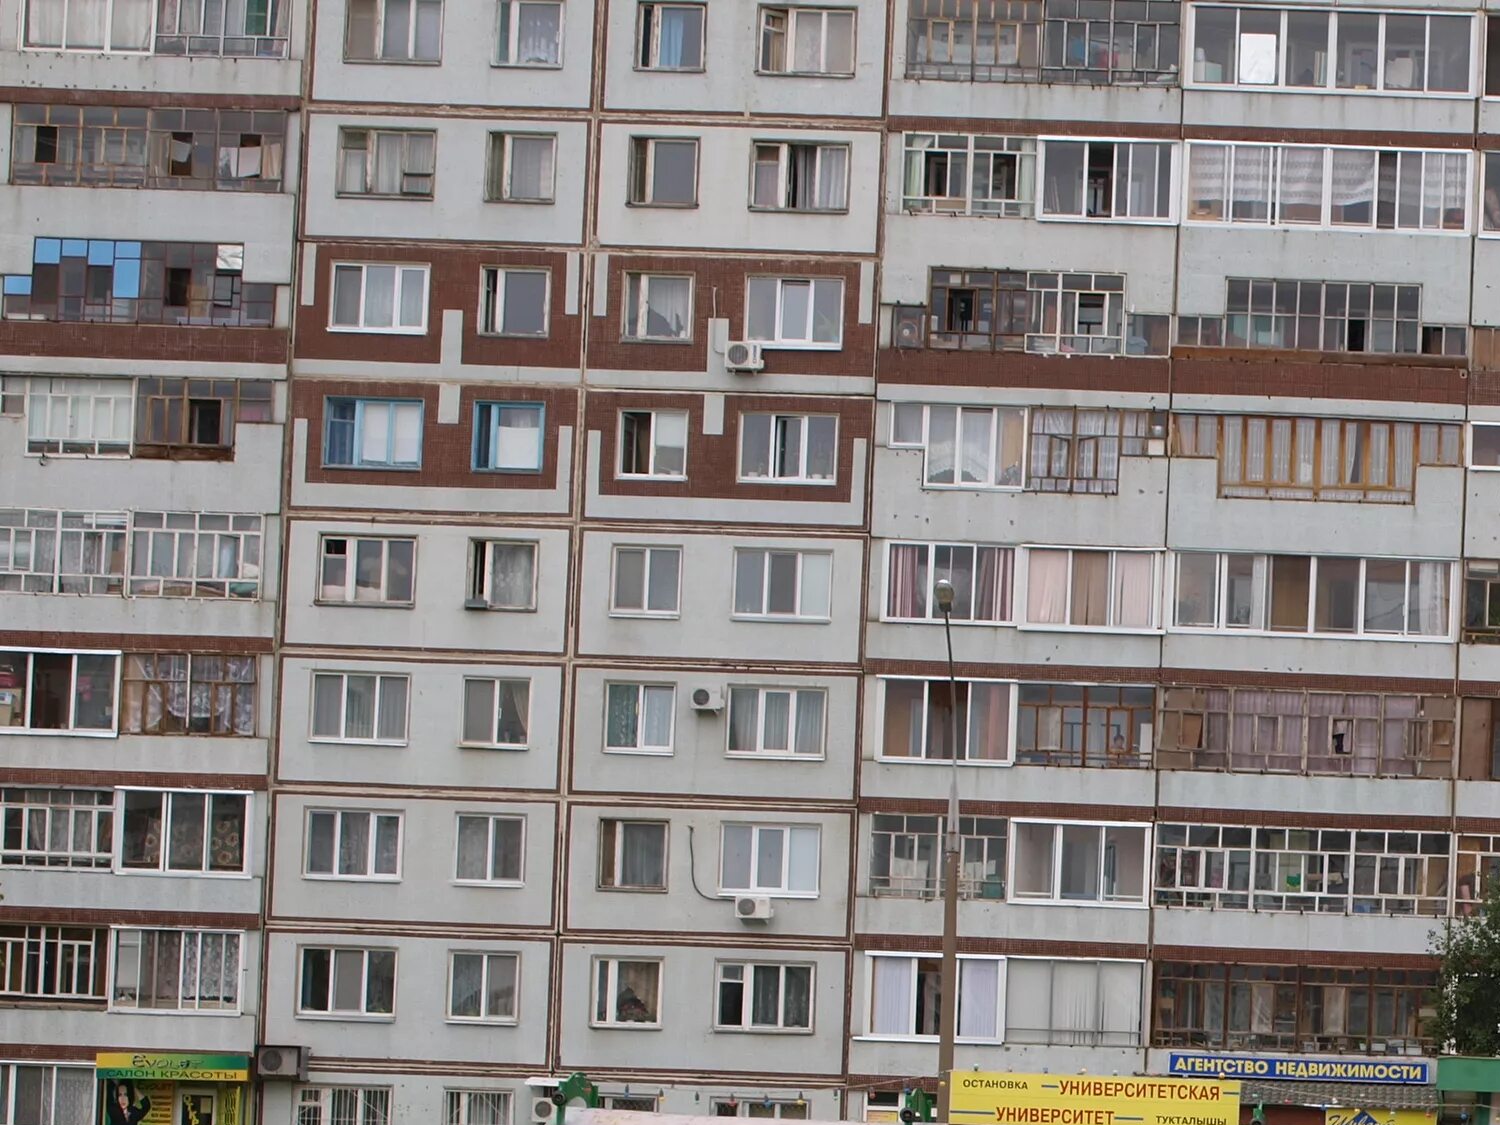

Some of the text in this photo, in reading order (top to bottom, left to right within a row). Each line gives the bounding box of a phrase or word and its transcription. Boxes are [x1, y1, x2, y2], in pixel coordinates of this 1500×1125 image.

[106, 1069, 237, 1080] САЛОН КРАСОТЫ
[1174, 1057, 1422, 1080] АГЕНТСТВО НЕДВИЖИМОСТИ
[962, 1078, 1221, 1102] ОСТАНОВКА УНИВЕРСИТЕТСКАЯ
[995, 1106, 1116, 1125] УНИВЕРСИТЕТ
